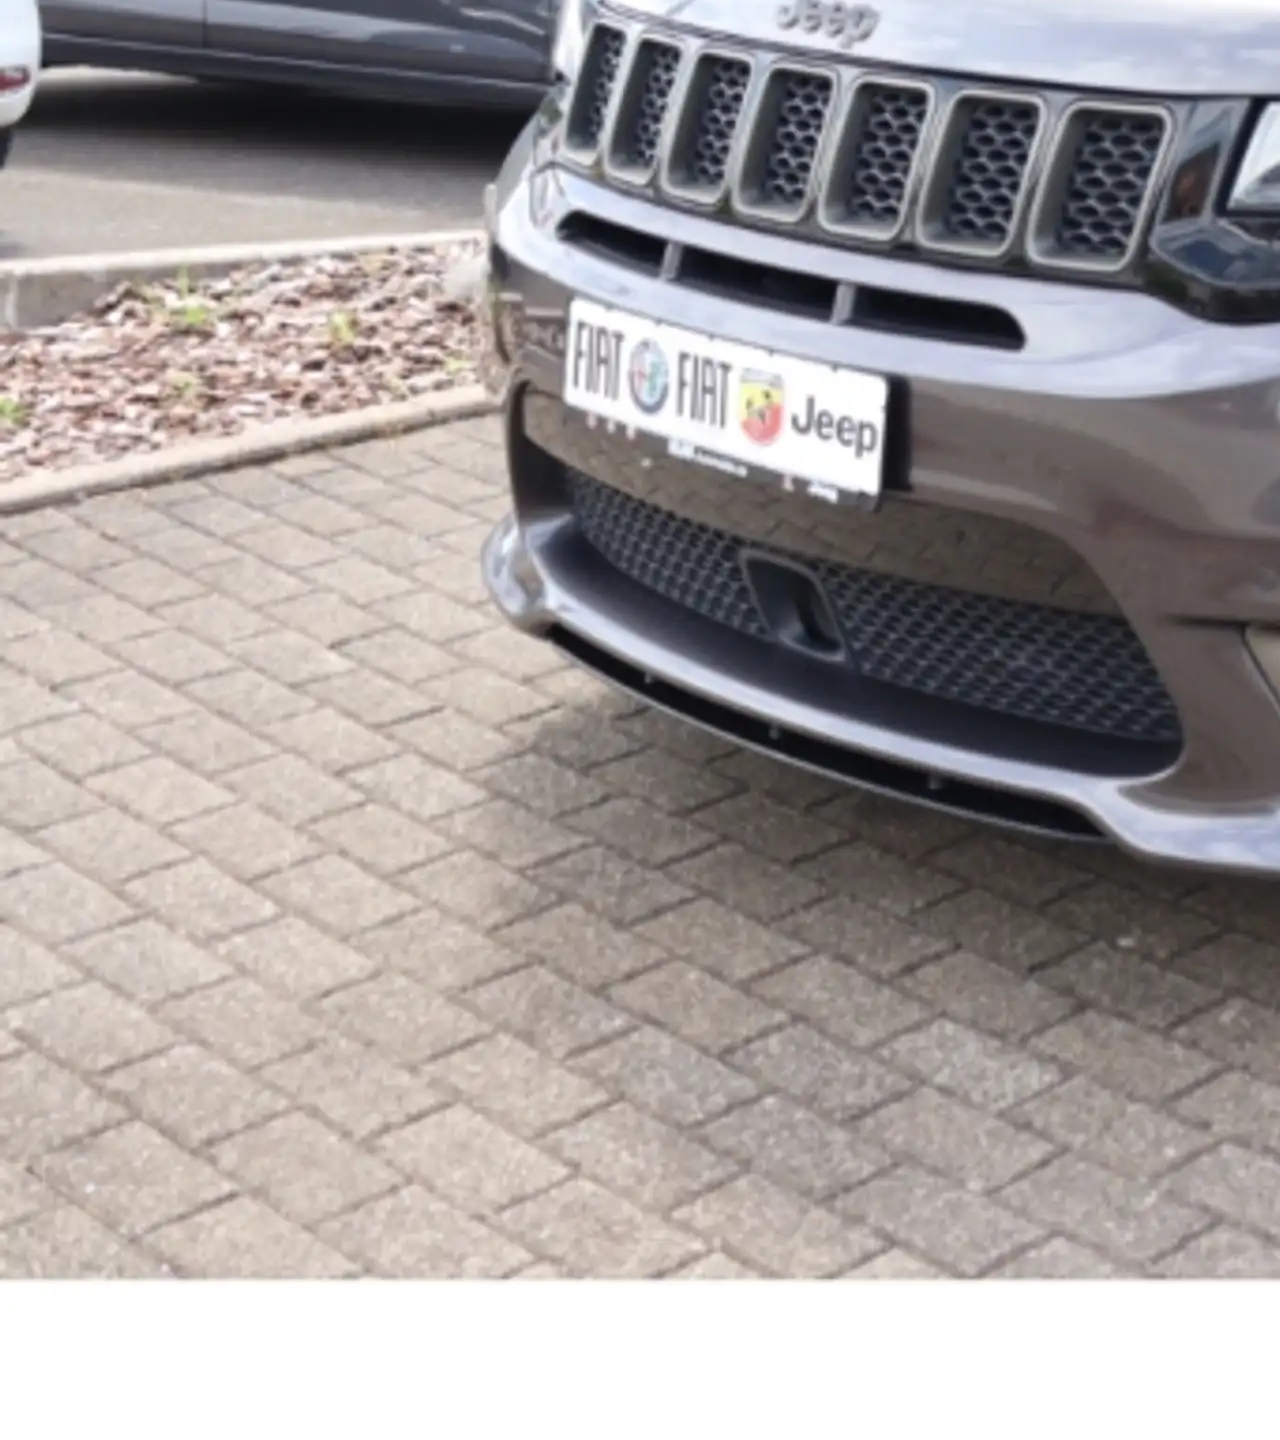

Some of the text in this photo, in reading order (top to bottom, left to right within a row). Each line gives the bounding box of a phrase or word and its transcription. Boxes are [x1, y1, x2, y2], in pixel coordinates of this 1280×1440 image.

[573, 321, 878, 457] FIAT FIAT Jeep
